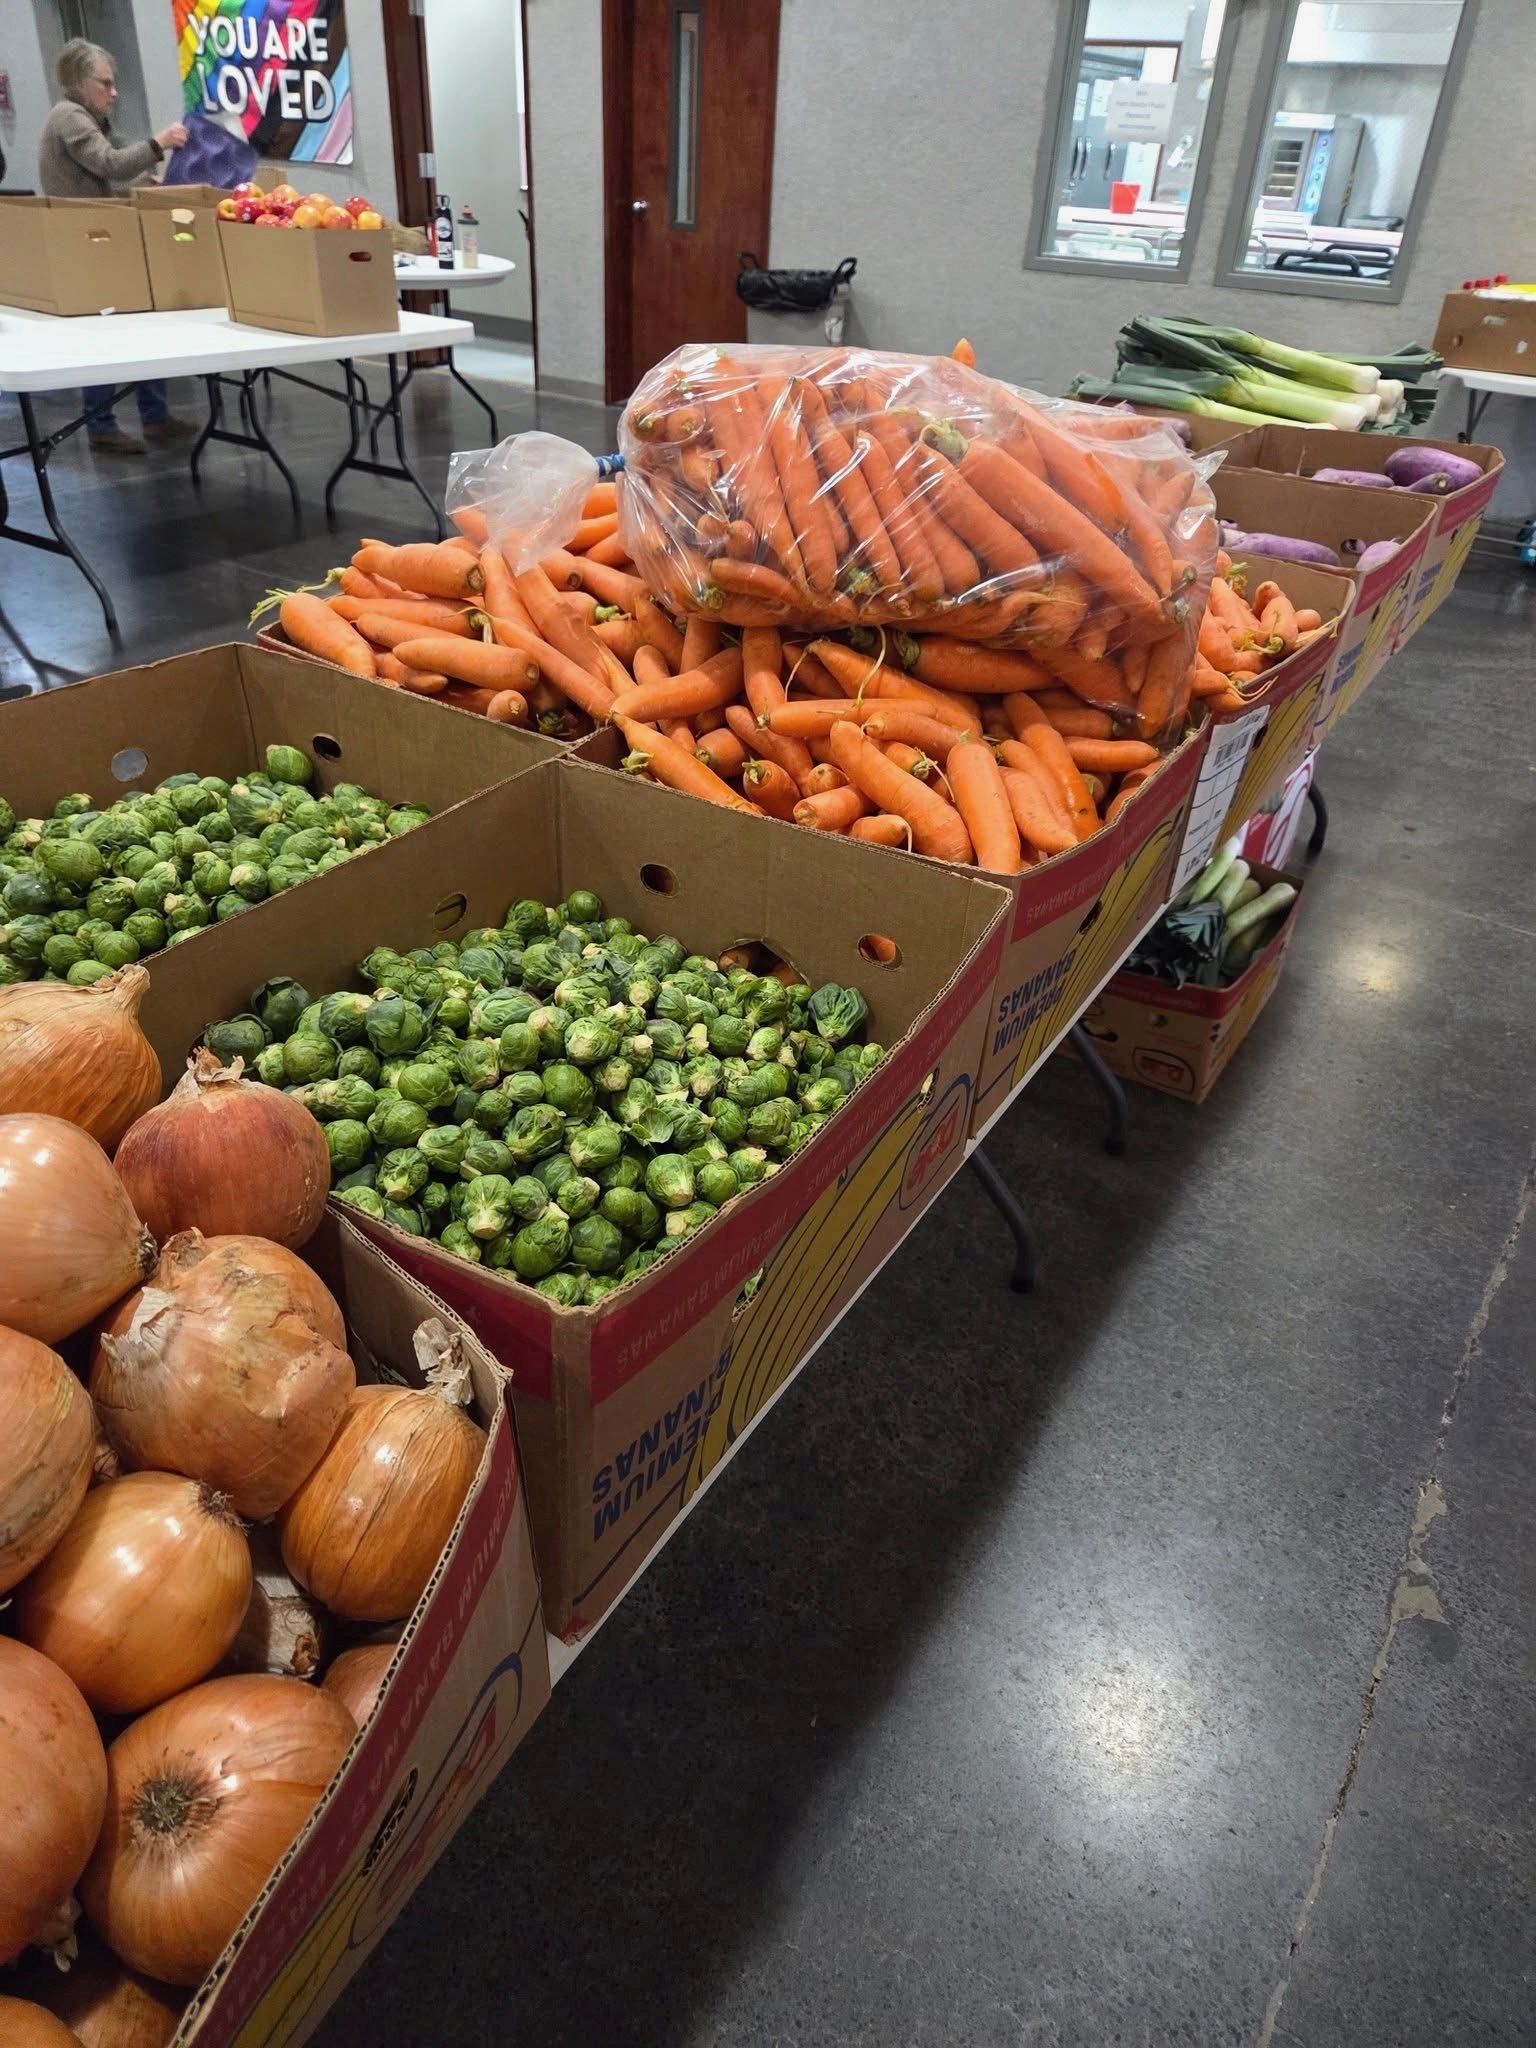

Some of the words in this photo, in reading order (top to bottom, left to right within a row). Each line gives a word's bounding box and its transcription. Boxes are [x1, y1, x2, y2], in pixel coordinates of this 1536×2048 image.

[187, 13, 259, 60] YOU
[263, 18, 329, 62] ARE
[196, 62, 335, 121] LOVED
[992, 978, 1066, 1056] PREMIUM
[997, 949, 1078, 1024] BANANAS
[616, 1282, 711, 1374] BANANAS
